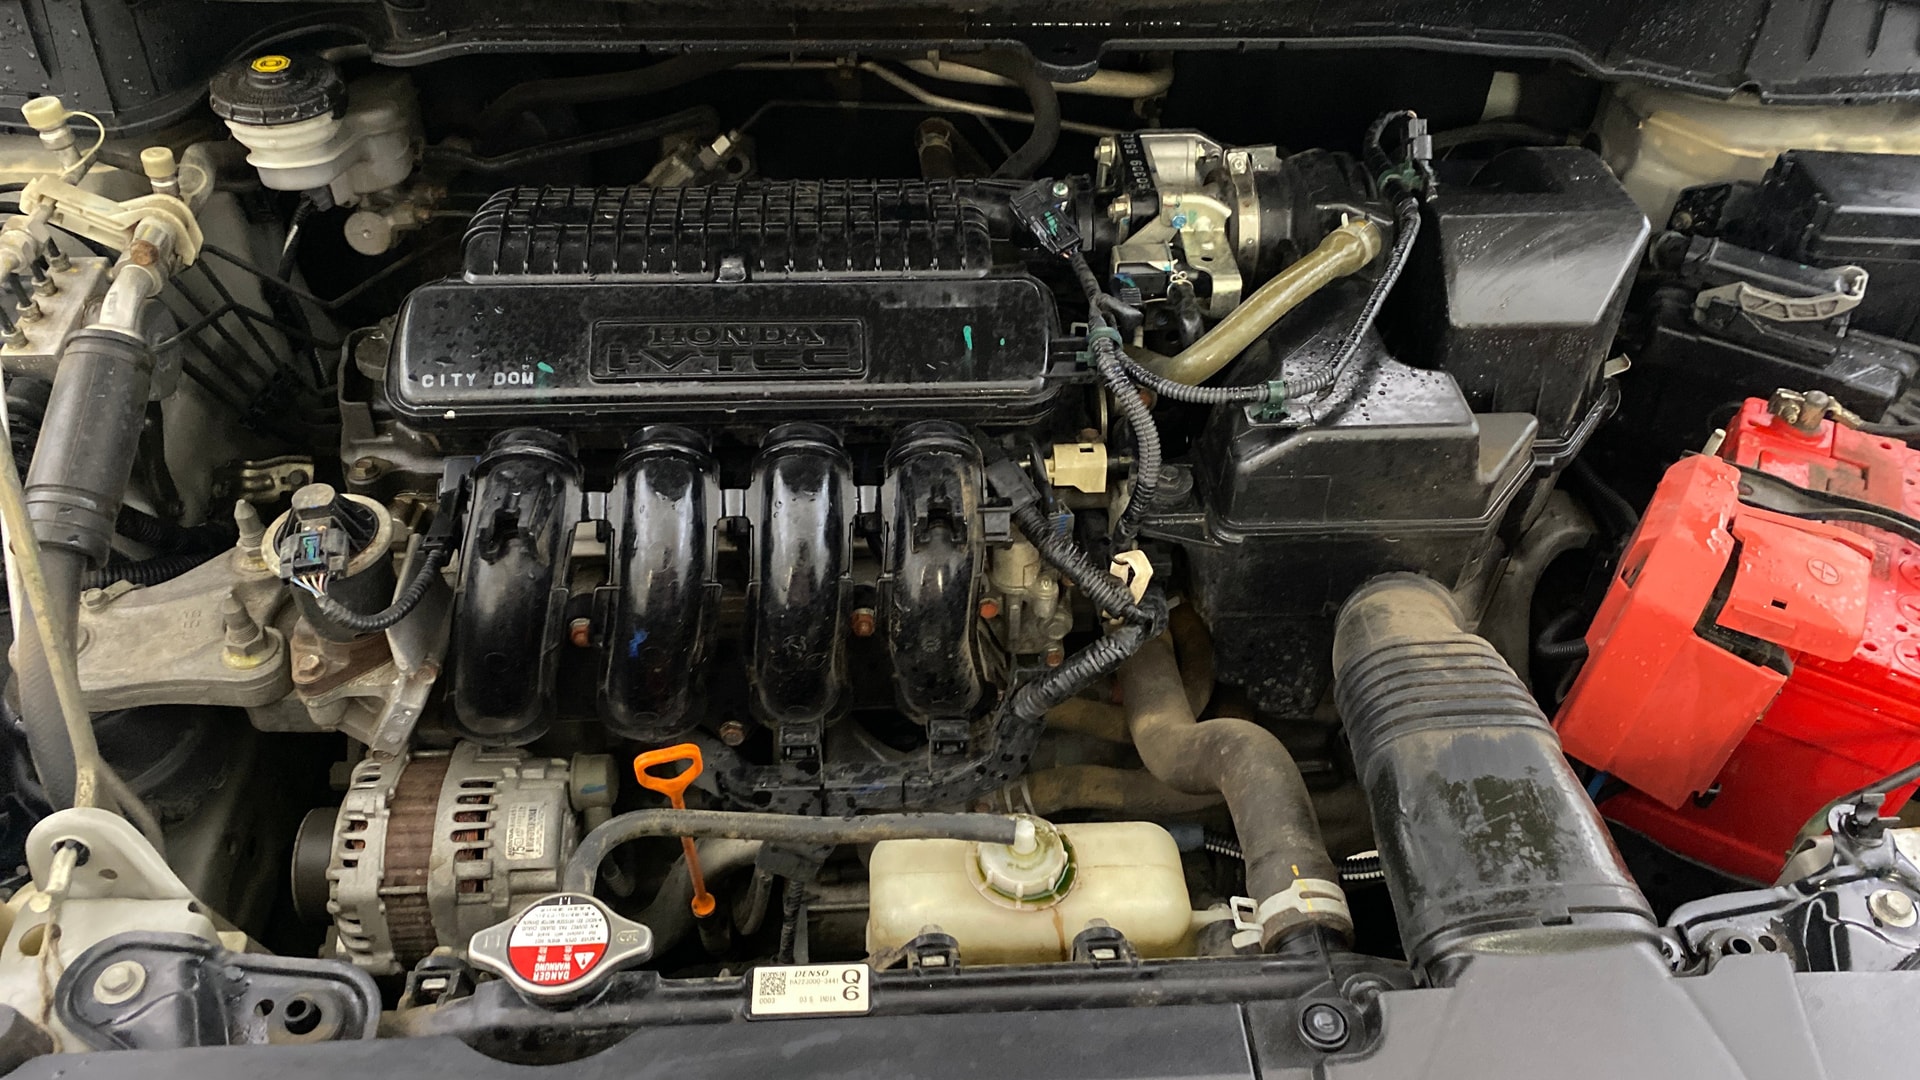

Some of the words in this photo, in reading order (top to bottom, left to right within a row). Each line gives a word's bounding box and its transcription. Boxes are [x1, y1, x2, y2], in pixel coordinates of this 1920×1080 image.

[648, 327, 825, 347] HONDA
[421, 373, 476, 388] CITY
[493, 371, 534, 386] DOM
[559, 896, 571, 905] 1.1
[534, 962, 571, 971] WARNUNG
[532, 970, 570, 981] DANGER
[794, 969, 829, 978] DENSO
[841, 969, 861, 985] Q
[842, 985, 860, 1001] 6
